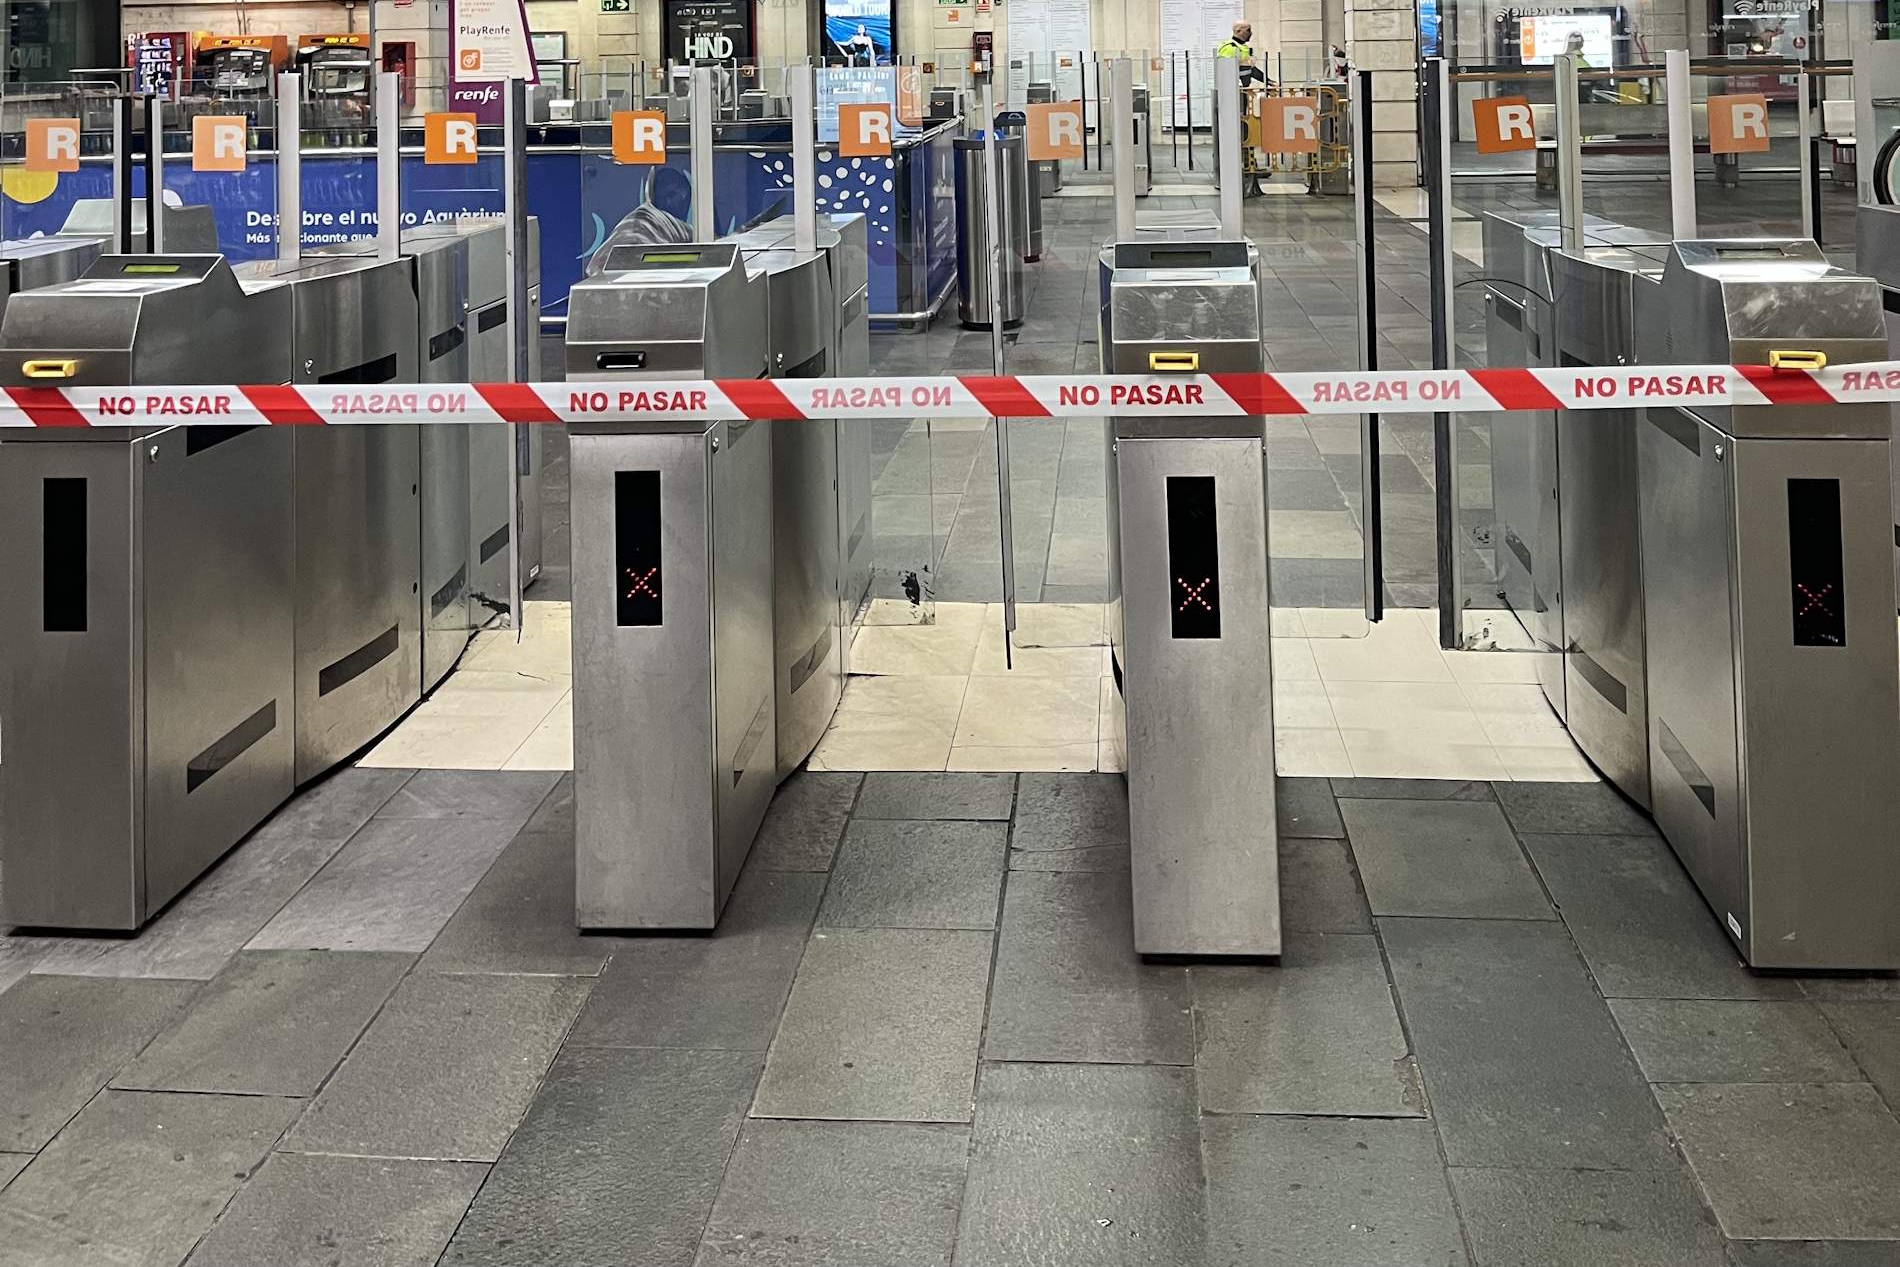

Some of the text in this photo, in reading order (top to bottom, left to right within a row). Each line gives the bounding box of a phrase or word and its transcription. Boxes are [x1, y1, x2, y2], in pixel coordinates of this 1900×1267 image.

[460, 25, 511, 36] PlayRenfe
[684, 36, 734, 59] HIND
[454, 86, 499, 105] renfe
[632, 118, 664, 152] R
[859, 110, 892, 144] R
[1047, 112, 1081, 146] R
[1283, 105, 1316, 140] R
[1496, 104, 1534, 141] R
[1731, 103, 1767, 139] R
[47, 127, 79, 160] R
[214, 124, 244, 159] R
[445, 120, 476, 154] R
[246, 210, 333, 227] Desbre
[339, 210, 355, 225] el
[246, 232, 271, 244] Más
[569, 389, 708, 412] NO PASAR
[1059, 384, 1203, 406] NO PASAR
[1574, 375, 1727, 398] NO PASAR
[98, 395, 232, 416] NO PASAR
